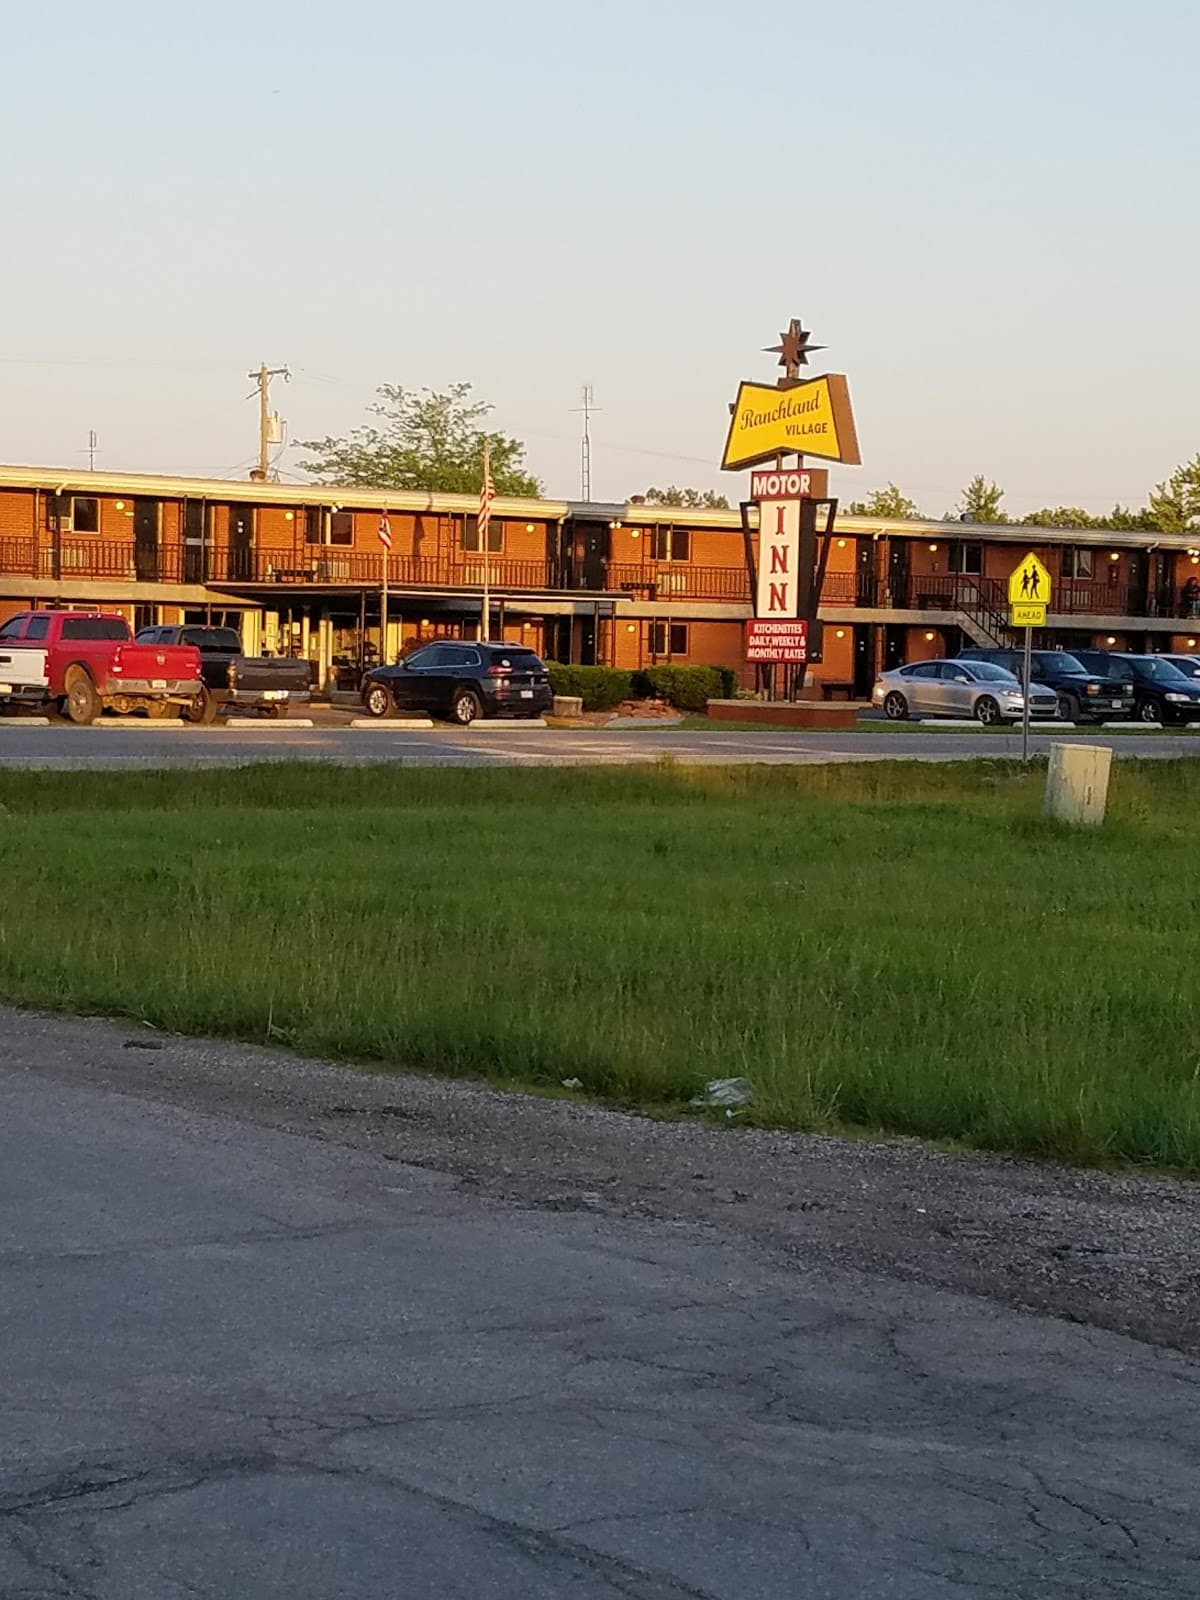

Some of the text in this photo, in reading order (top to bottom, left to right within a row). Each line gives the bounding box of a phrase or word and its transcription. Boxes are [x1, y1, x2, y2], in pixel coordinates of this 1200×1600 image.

[741, 390, 820, 430] Ranchland
[785, 422, 828, 436] VILLAGE
[753, 474, 810, 496] MOTOR
[768, 506, 790, 612] INN
[1017, 611, 1042, 619] AHEAD
[772, 636, 799, 646] WEEKLY
[800, 636, 806, 646] &
[747, 648, 806, 659] MONTHLY RATES
